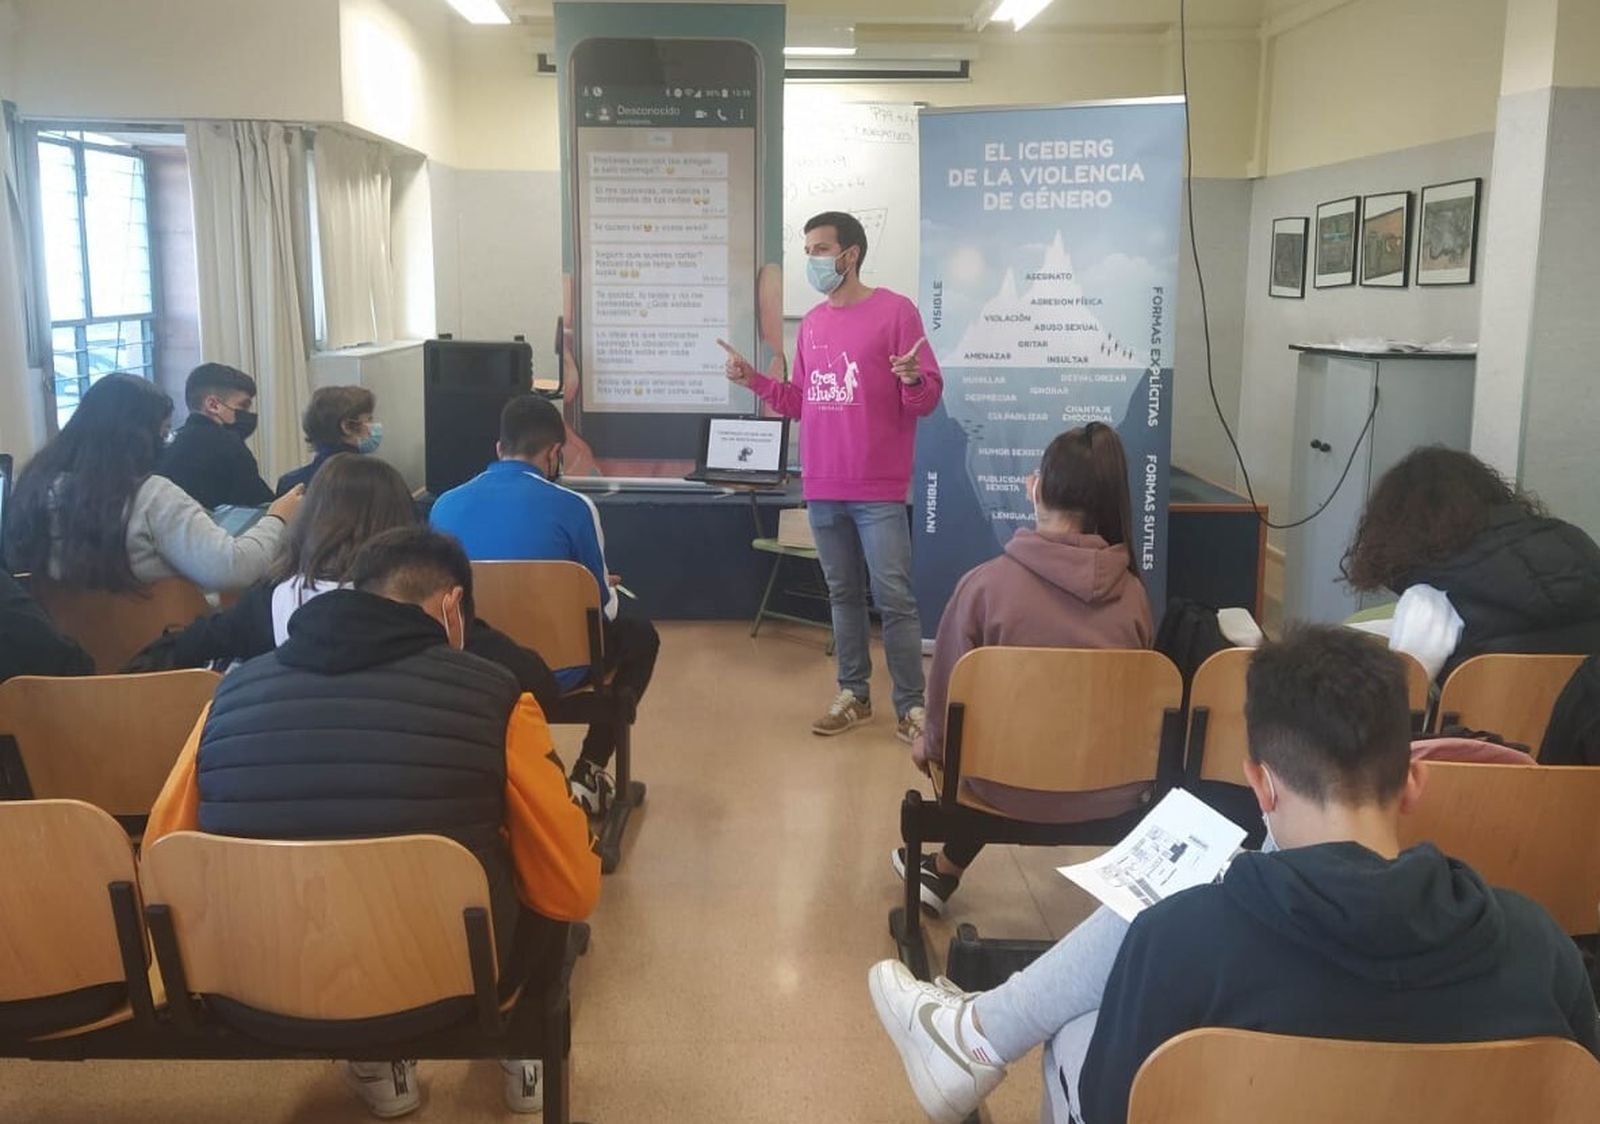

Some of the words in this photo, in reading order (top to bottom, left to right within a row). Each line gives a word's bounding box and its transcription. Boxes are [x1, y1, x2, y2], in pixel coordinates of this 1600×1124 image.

[616, 104, 681, 116] Desconocido
[984, 143, 1011, 161] EL
[1018, 139, 1115, 160] ICEBERG
[948, 168, 978, 187] DE
[983, 167, 1013, 186] LA
[1020, 163, 1145, 185] VIOLENCIA
[983, 192, 1013, 210] DE
[1020, 187, 1113, 209] GÉNERO
[932, 280, 943, 330] VISIBLE
[1075, 296, 1103, 305] FÍSICA
[984, 313, 1031, 322] VIOLACIÓN
[1150, 286, 1163, 345] FORMAS
[1064, 323, 1099, 331] SEXUAL
[964, 352, 1011, 360] AMENAZAR
[962, 376, 1005, 384] HUMILLAR
[1061, 374, 1127, 383] DESVALORIZAR
[1029, 386, 1069, 395] IGNORAR
[1147, 348, 1162, 427] EXPLÍCITAS
[1064, 405, 1112, 413] CHANTAJE
[987, 412, 1049, 421] CULPABILIZAR
[1062, 413, 1113, 423] EMOCIONAL
[978, 447, 1010, 456] HUMOR
[986, 483, 1020, 492] SEXISTA
[1143, 454, 1158, 512] FORMAS
[926, 471, 938, 533] INVISIBLE
[1142, 514, 1155, 571] SUTILES
